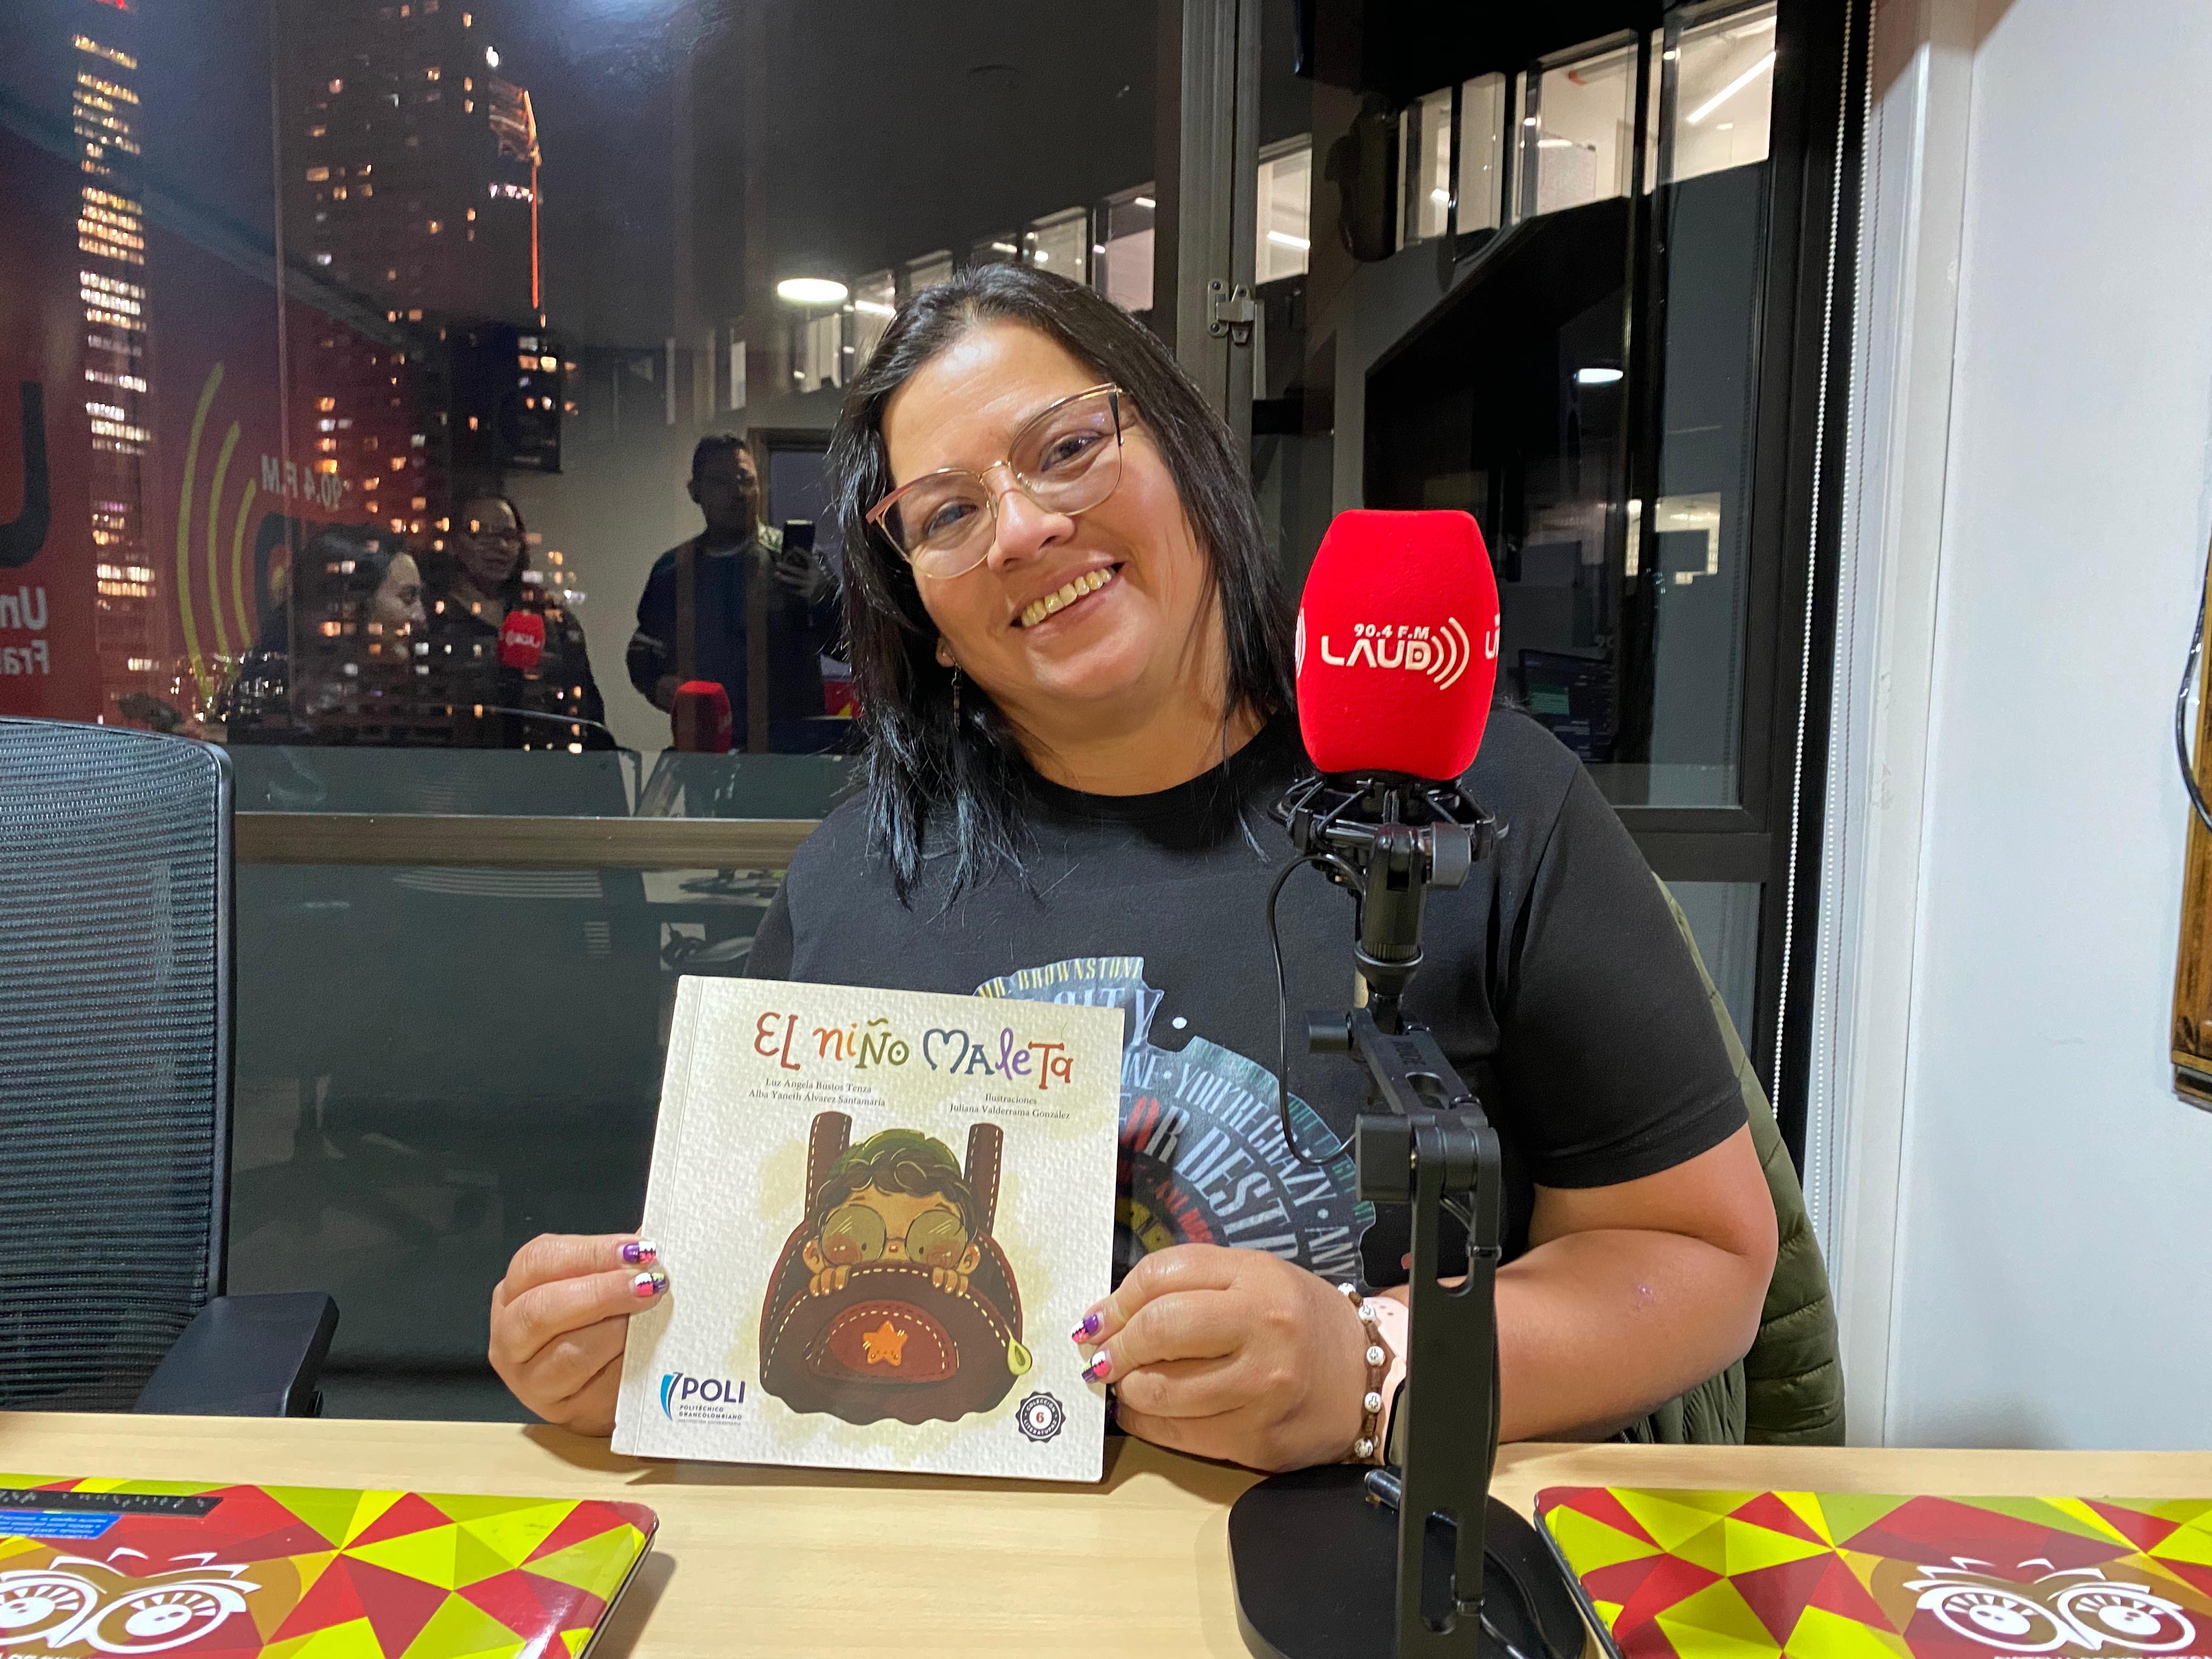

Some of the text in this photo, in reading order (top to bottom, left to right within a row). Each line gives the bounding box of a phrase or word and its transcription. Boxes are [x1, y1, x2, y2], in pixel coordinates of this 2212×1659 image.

[1353, 623, 1430, 640] 90.4 F.M
[1321, 635, 1432, 670] LAUD
[748, 1089, 769, 1098] Alba
[803, 1091, 837, 1103] Álvarez
[985, 1093, 1037, 1105] Ilustraciones
[950, 1103, 1071, 1120] Juliana Valderrama González
[681, 1377, 746, 1404] POLI
[1036, 1412, 1045, 1423] 6
